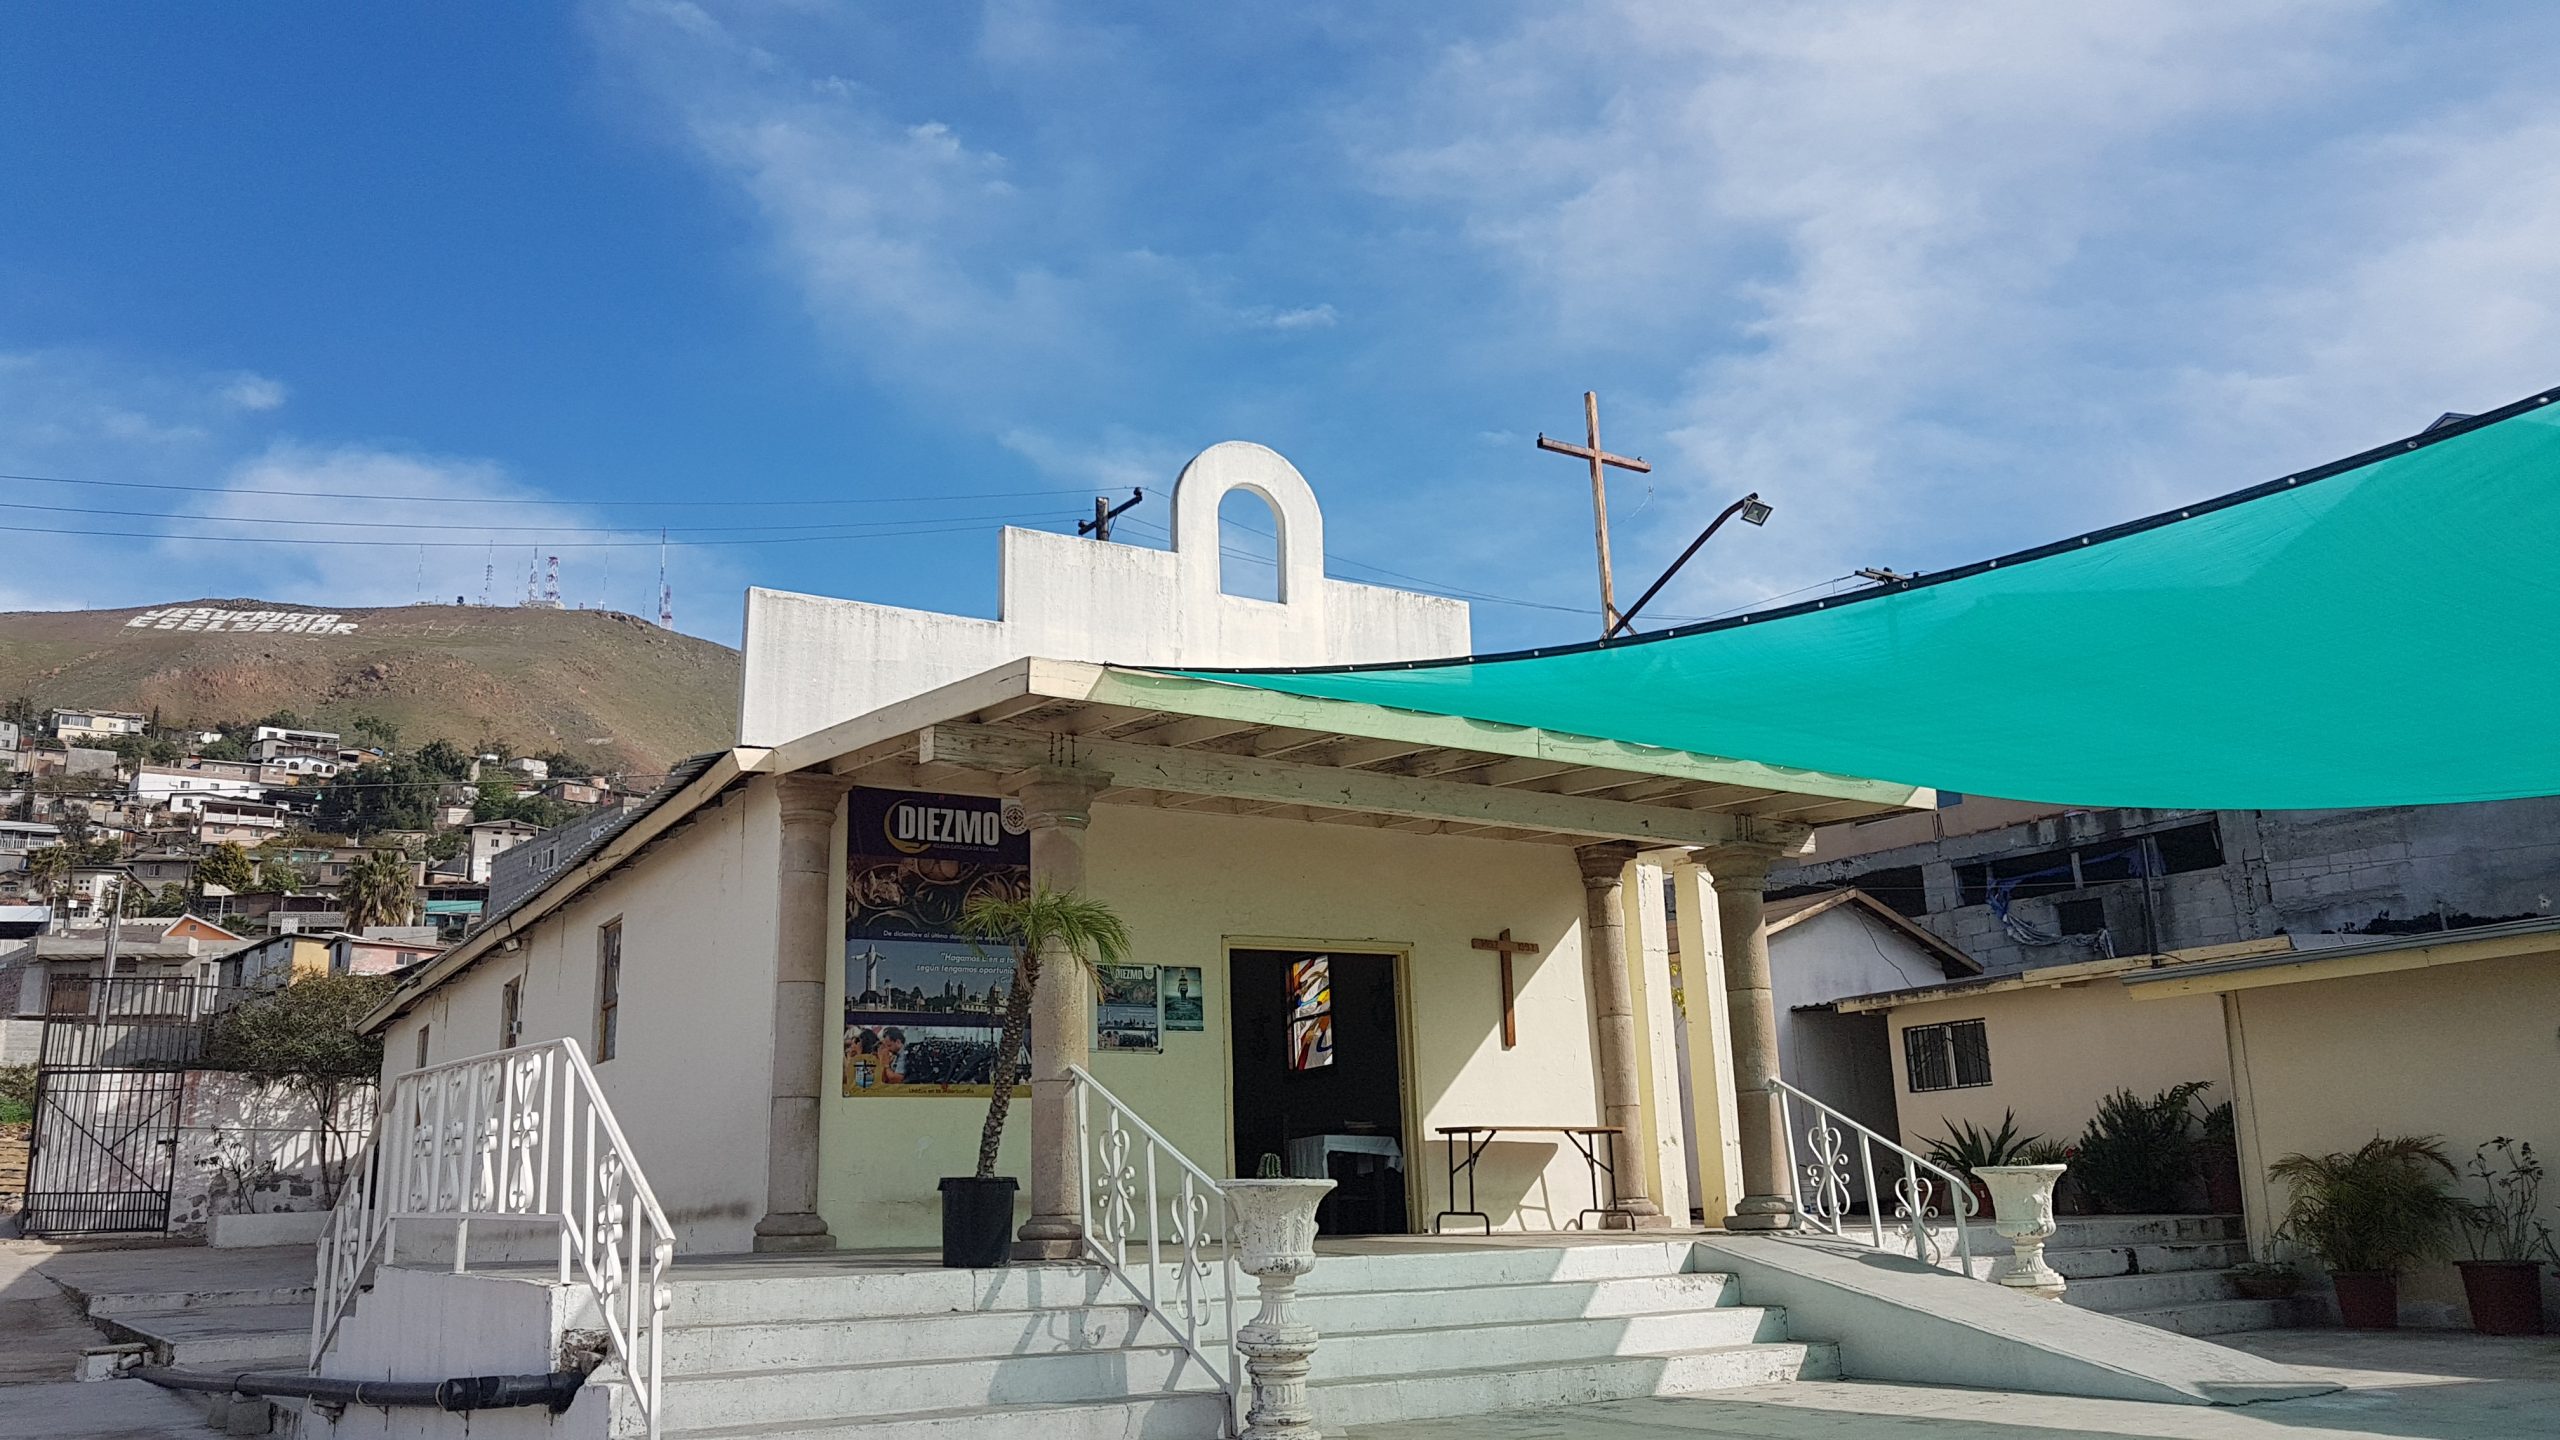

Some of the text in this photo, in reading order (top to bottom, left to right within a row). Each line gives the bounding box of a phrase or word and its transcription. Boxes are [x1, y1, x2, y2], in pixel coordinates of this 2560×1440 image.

[146, 608, 341, 623] JESUCRISTO
[898, 805, 1000, 846] DIEZMO
[893, 930, 923, 938] diciembre
[916, 964, 939, 973] según
[941, 964, 977, 974] tengamos
[1114, 969, 1143, 980] DIEZMO
